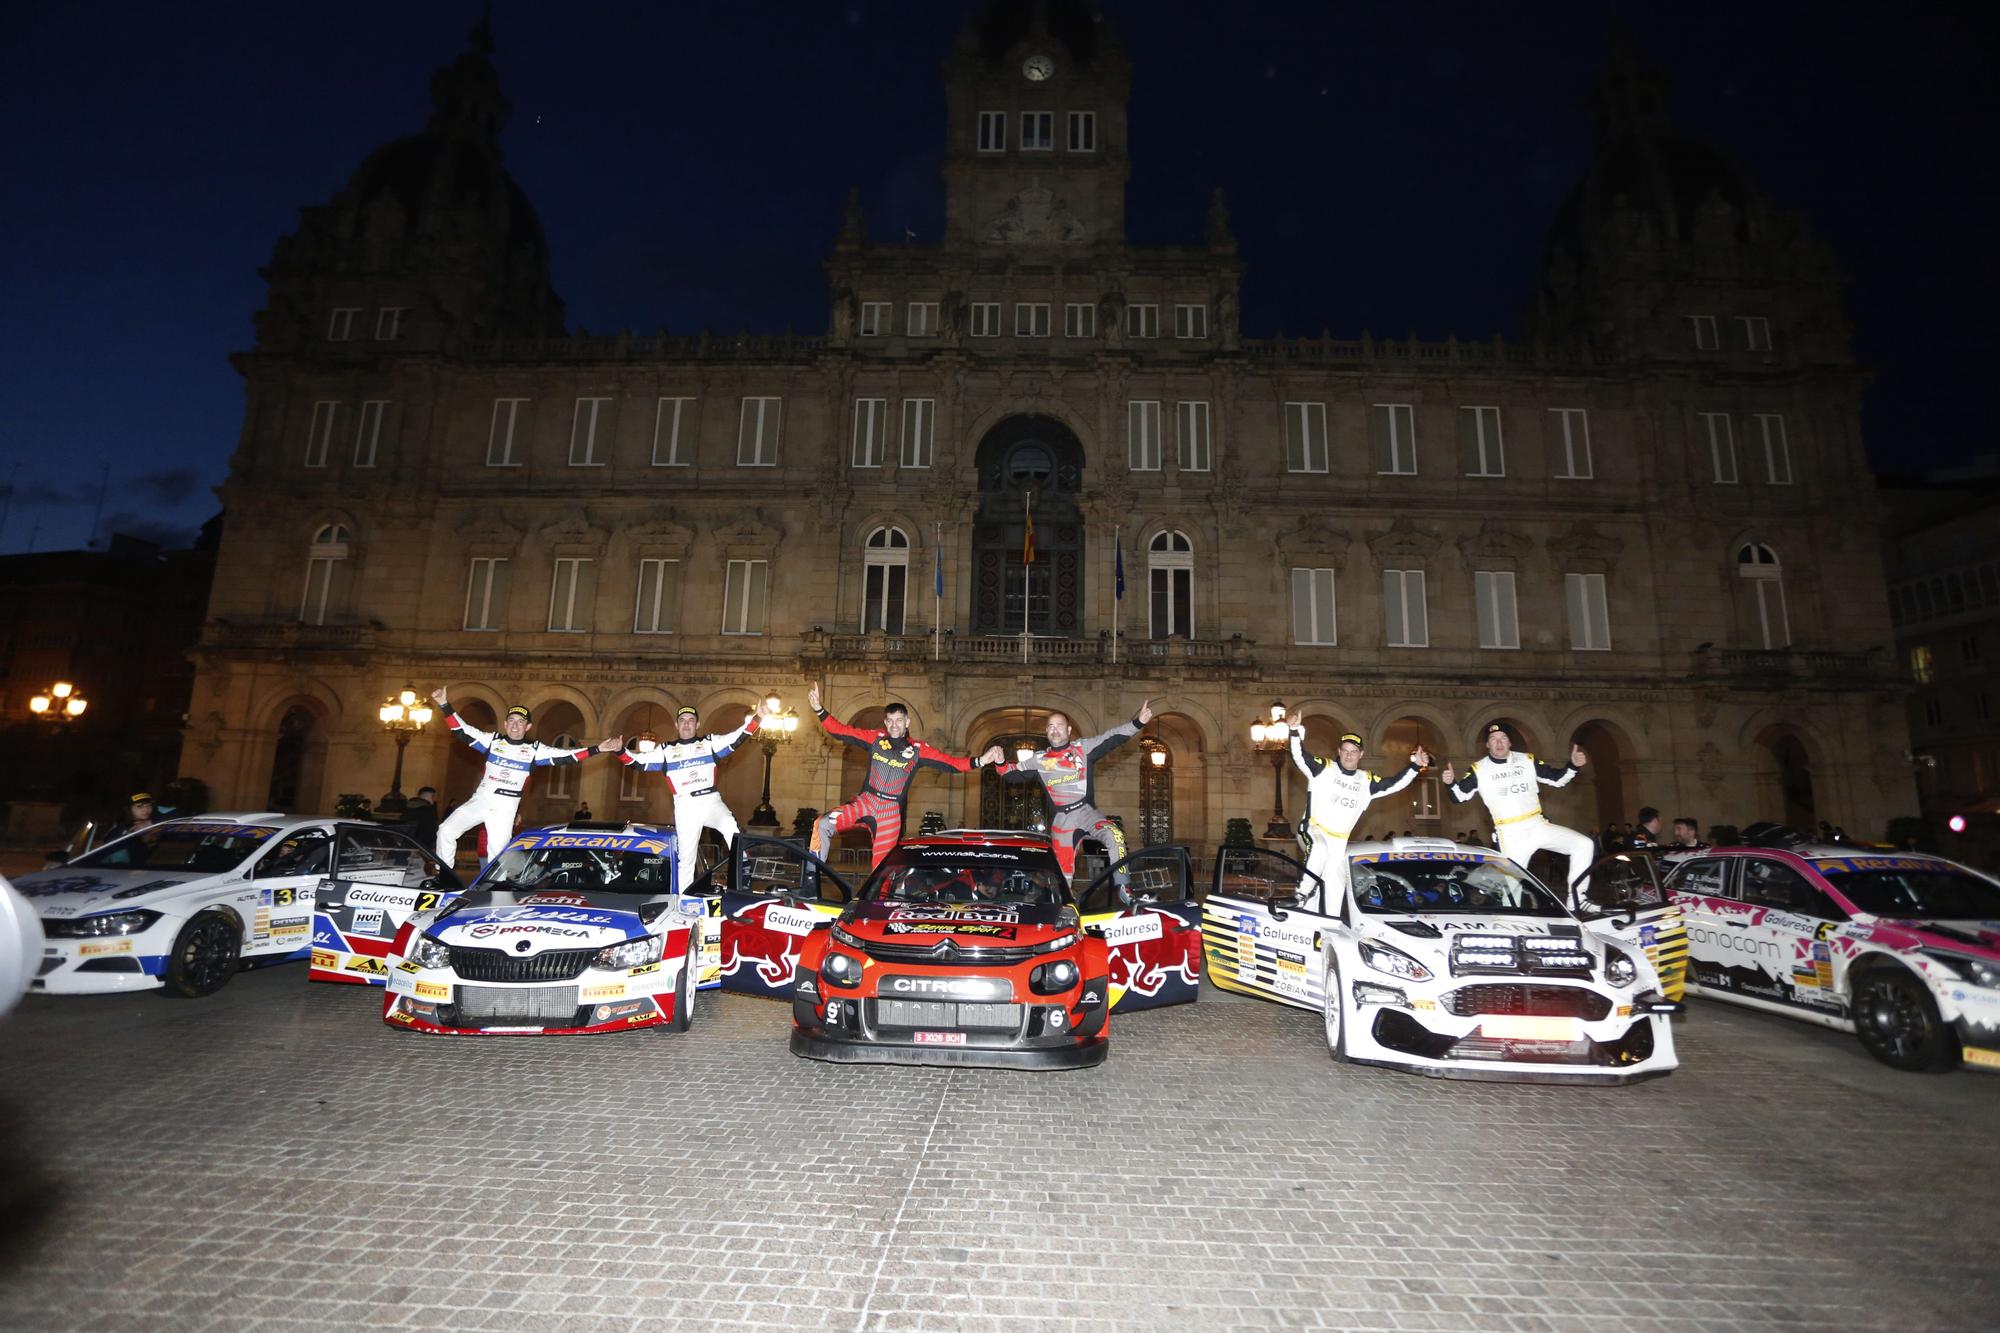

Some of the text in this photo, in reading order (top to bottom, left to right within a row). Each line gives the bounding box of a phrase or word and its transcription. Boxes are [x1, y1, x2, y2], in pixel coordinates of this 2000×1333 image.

[543, 836, 633, 849] Recalvi
[1388, 852, 1476, 861] Recalvi
[279, 889, 294, 906] 3
[350, 890, 414, 906] Galuresa
[418, 893, 437, 911] 2
[888, 911, 1019, 924] Red Bull
[1764, 913, 1814, 934] Galuresa
[499, 926, 589, 939] PROMEGA
[957, 925, 1002, 935] Sport
[1104, 924, 1159, 940] Galuresa
[1263, 926, 1312, 945] Galuresa
[1817, 923, 1833, 941] 5
[415, 983, 448, 996] PIRELLI
[583, 985, 625, 997] PIRELLI
